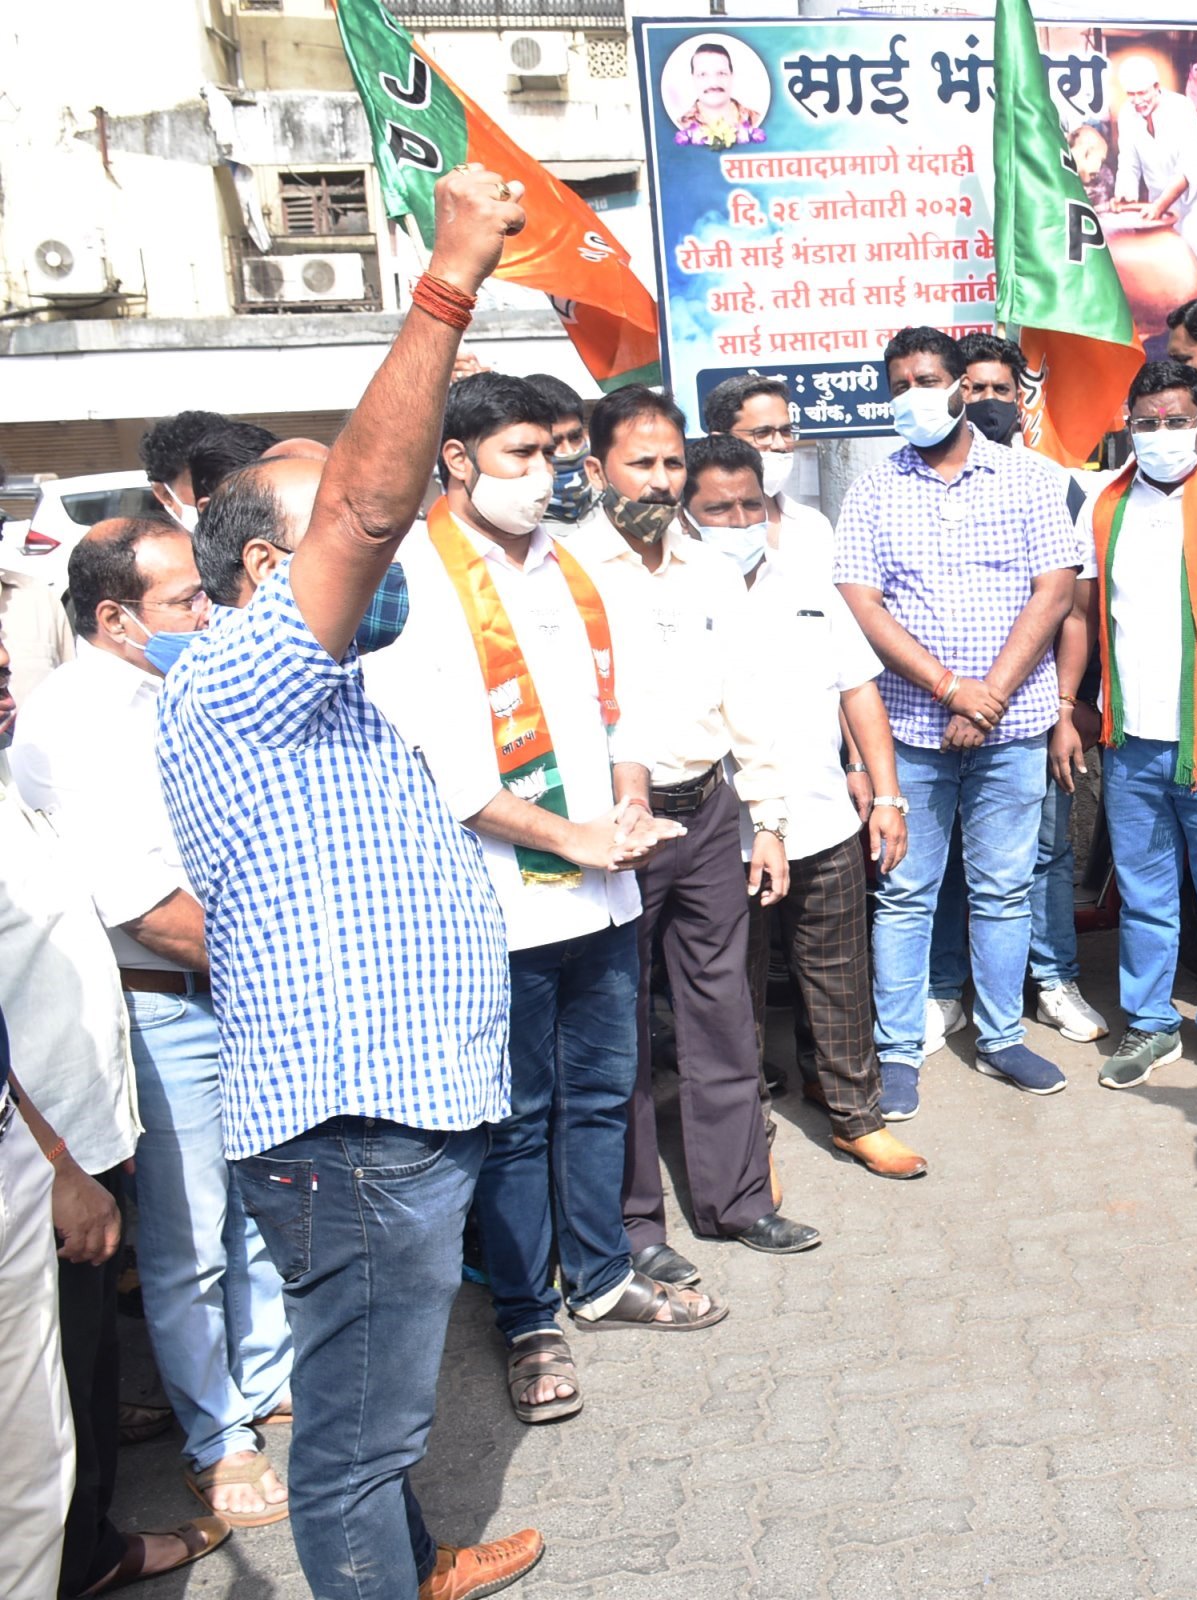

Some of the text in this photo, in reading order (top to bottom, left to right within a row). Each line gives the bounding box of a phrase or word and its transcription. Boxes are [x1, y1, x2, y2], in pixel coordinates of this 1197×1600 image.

[784, 34, 910, 124] साई
[724, 144, 975, 180] सालावादप्रमाणे यंदाही
[732, 190, 973, 226] दि. २६ जानेवारी २०२२
[680, 239, 732, 271] रोजी
[740, 237, 784, 269] साई
[791, 237, 856, 265] भंडारा
[865, 231, 969, 264] आयोजित
[710, 281, 764, 314] आहे.
[772, 280, 811, 310] तरी
[818, 277, 856, 307] सर्व
[863, 276, 906, 305] साई
[718, 325, 762, 357] साई
[768, 328, 868, 355] प्रसादाचा
[811, 363, 879, 400] दुपारी
